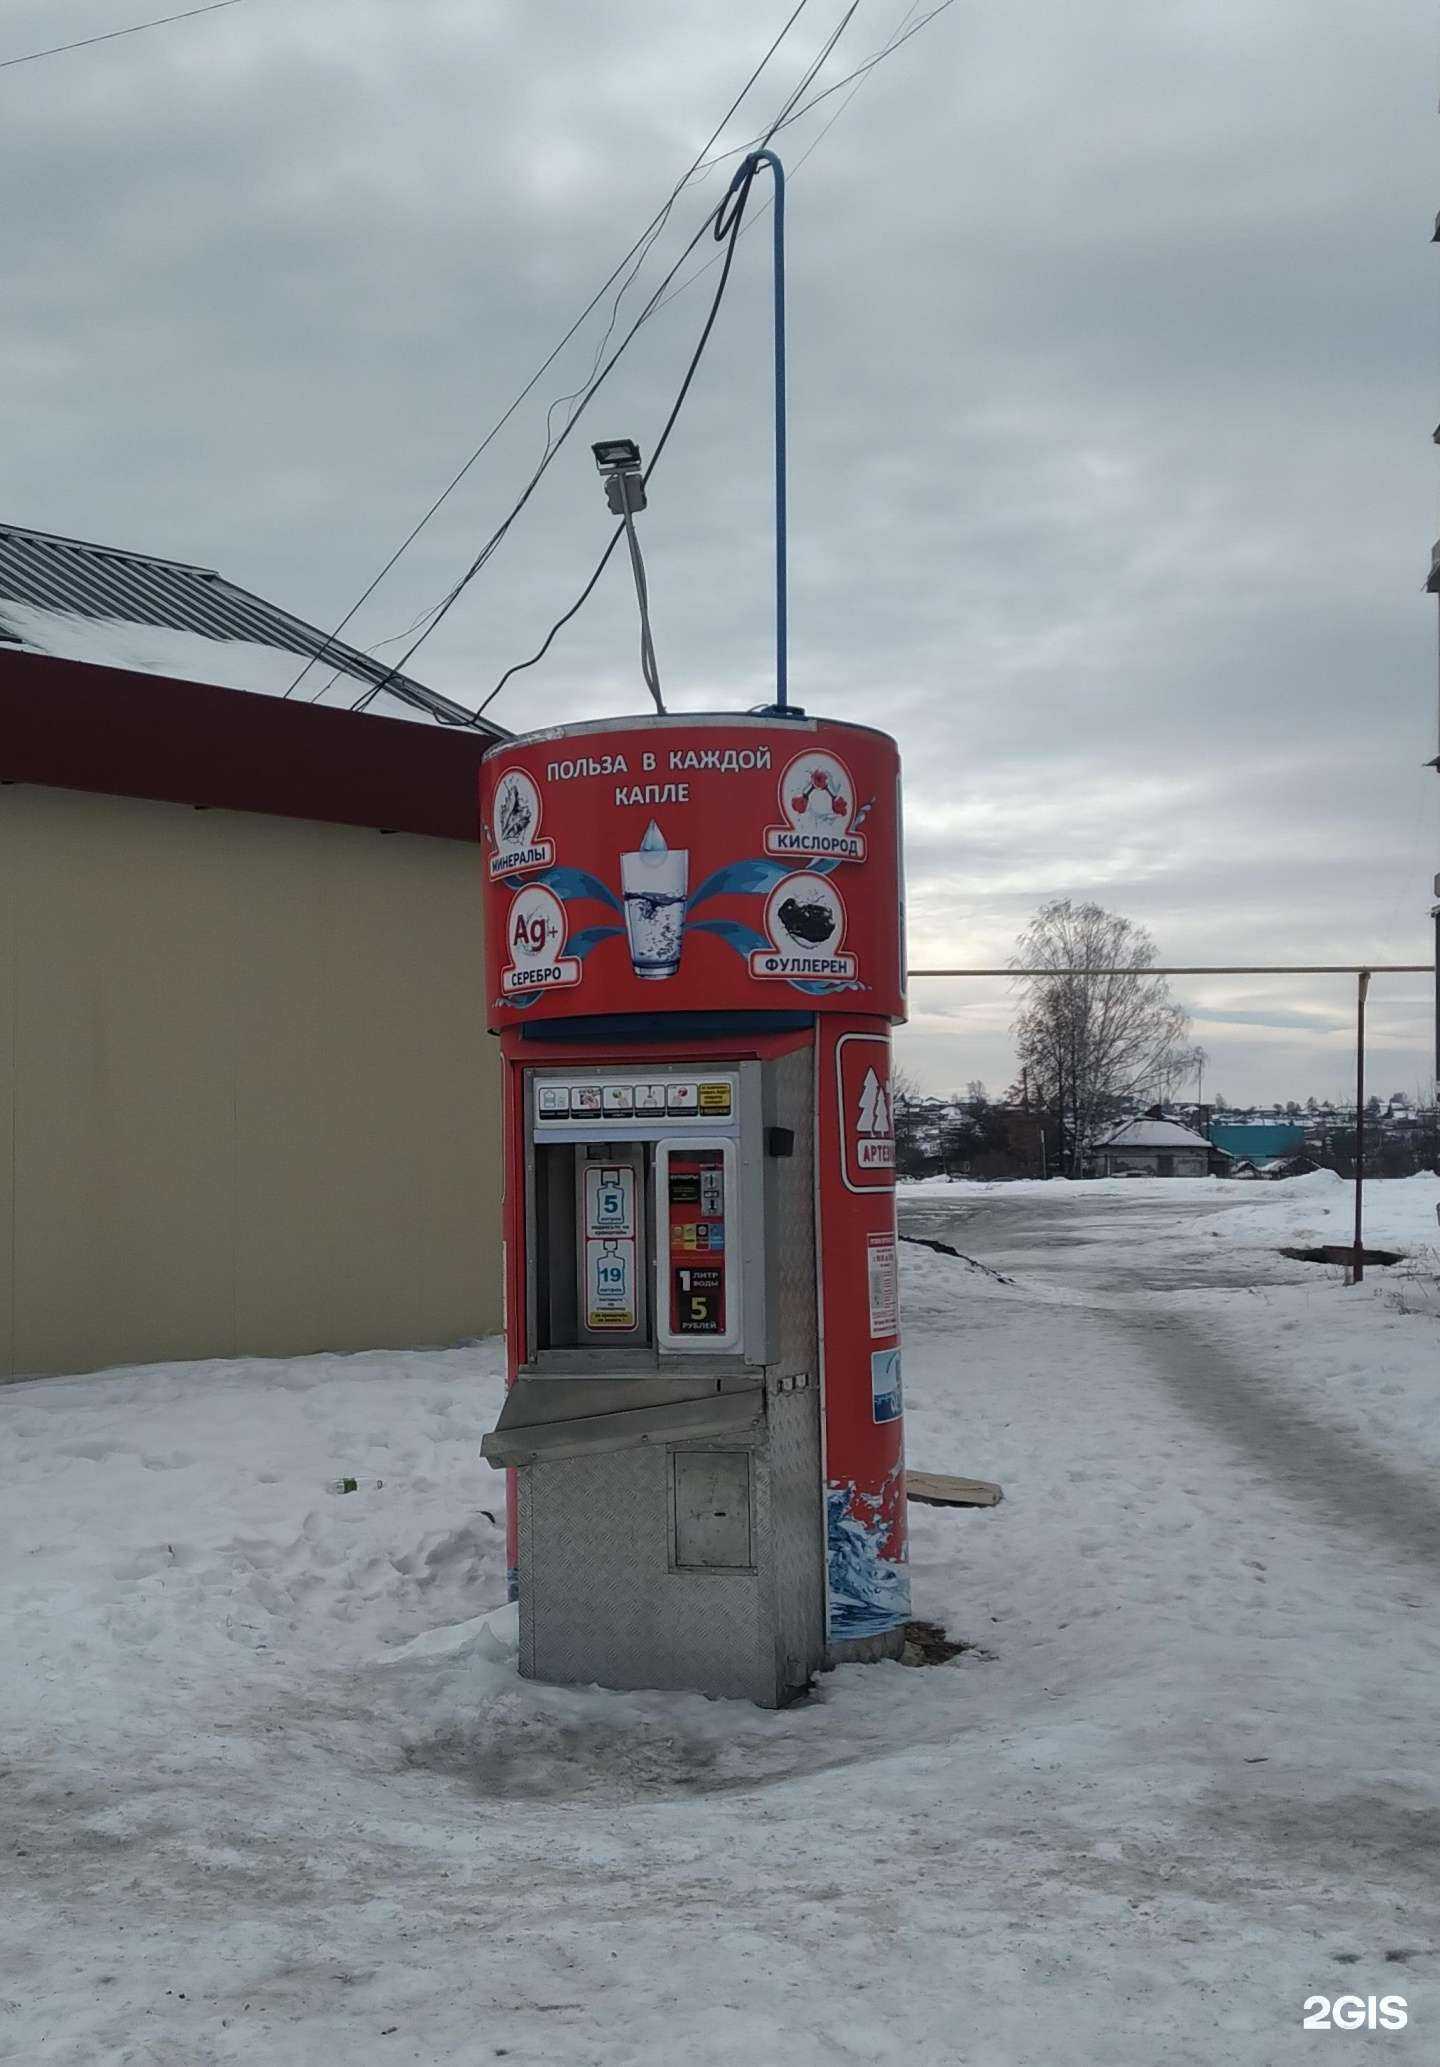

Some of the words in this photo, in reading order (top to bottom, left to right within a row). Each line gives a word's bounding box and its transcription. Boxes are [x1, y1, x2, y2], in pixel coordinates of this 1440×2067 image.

[547, 755, 628, 782] ПОЛЬЗА
[642, 752, 657, 771] В
[669, 746, 772, 773] КАЖДОЙ
[615, 783, 690, 806] КАПЛЕ
[777, 834, 859, 856] КИСЛОРОД
[491, 846, 546, 873] МИНЕРАЛЫ
[511, 966, 562, 987] СЕРЕБРО
[765, 958, 848, 974] ФУЛЛЕРЕН
[603, 1194, 618, 1213] 5
[600, 1267, 621, 1282] 19
[679, 1270, 691, 1292] 1
[691, 1297, 708, 1320] 5
[682, 1321, 717, 1329] РУБЛЕЙ
